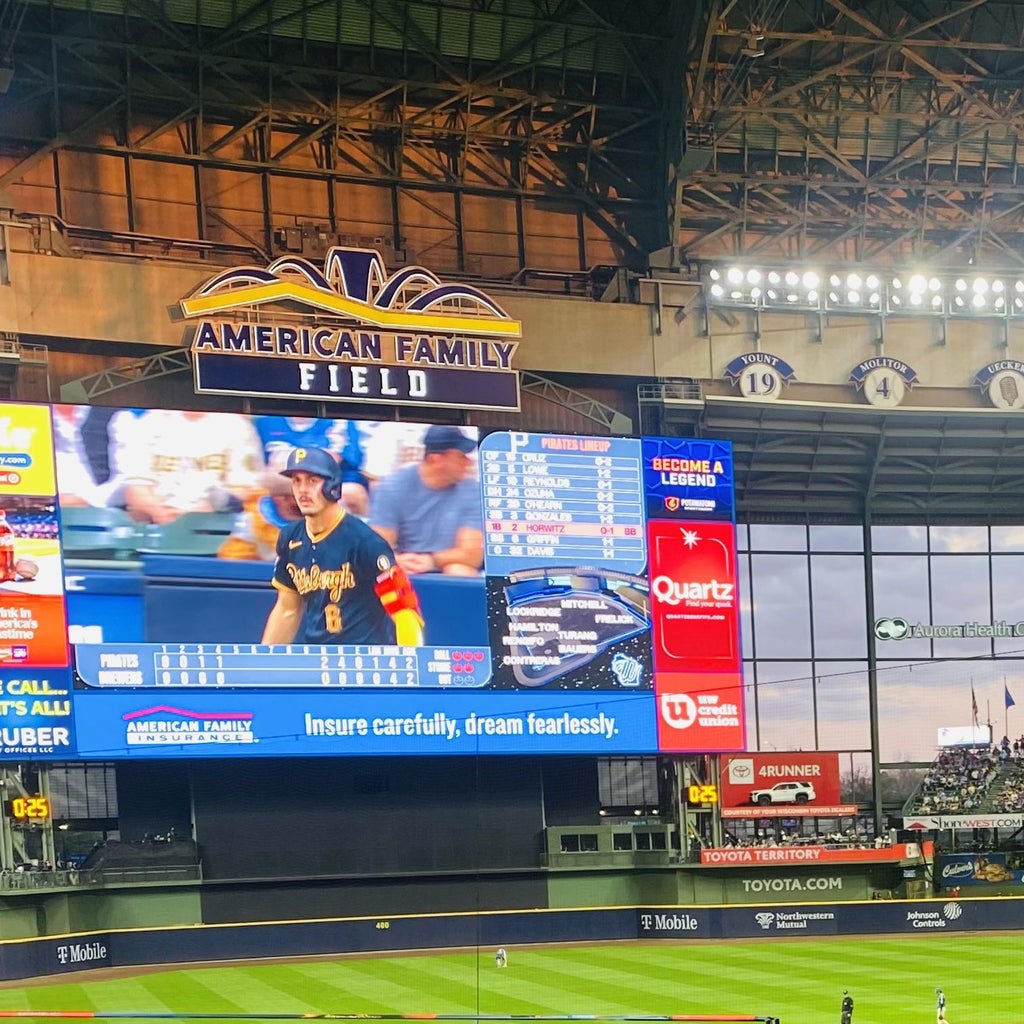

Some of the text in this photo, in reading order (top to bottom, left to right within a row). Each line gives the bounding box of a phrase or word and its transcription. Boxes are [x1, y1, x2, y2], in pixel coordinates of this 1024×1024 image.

[197, 321, 518, 369] AMERICAN FAMILY
[741, 353, 778, 366] YOUNT
[859, 358, 907, 374] MOLITOR
[299, 363, 428, 398] FIELD
[746, 373, 775, 396] 19
[876, 376, 889, 400] 4
[652, 458, 724, 474] BECOME A
[660, 472, 717, 487] LEGEND
[526, 524, 566, 534] HORWITZ
[652, 575, 734, 606] Quartz
[561, 600, 608, 610] MITCHELL
[595, 614, 634, 625] FRELICK
[508, 622, 560, 633] HAMILTON
[914, 624, 963, 637] Aurora
[964, 621, 1011, 637] Health
[558, 630, 598, 641] TURANG
[503, 655, 561, 666] CONTRERAS
[697, 695, 719, 704] uw
[30, 700, 70, 716] ALL!
[698, 705, 738, 716] credit
[126, 720, 253, 732] AMERICAN FAMILY
[304, 712, 619, 740] Insure carefully, dream fearlessly.
[698, 716, 739, 728] union
[138, 733, 243, 742] INSURANCE
[758, 764, 821, 777] 4RUNNER
[688, 784, 718, 804] 0:25
[12, 797, 49, 819] 0:25
[704, 848, 821, 863] TOYOTA TERRITORY
[742, 877, 842, 892] TOYOTA.COM
[641, 913, 698, 931] T Mobile
[776, 911, 835, 922] Northwestern
[907, 911, 940, 921] Johnson
[375, 921, 390, 930] 400
[777, 919, 807, 930] Mutual
[912, 918, 947, 928] Controls
[57, 942, 107, 965] T Mobile
